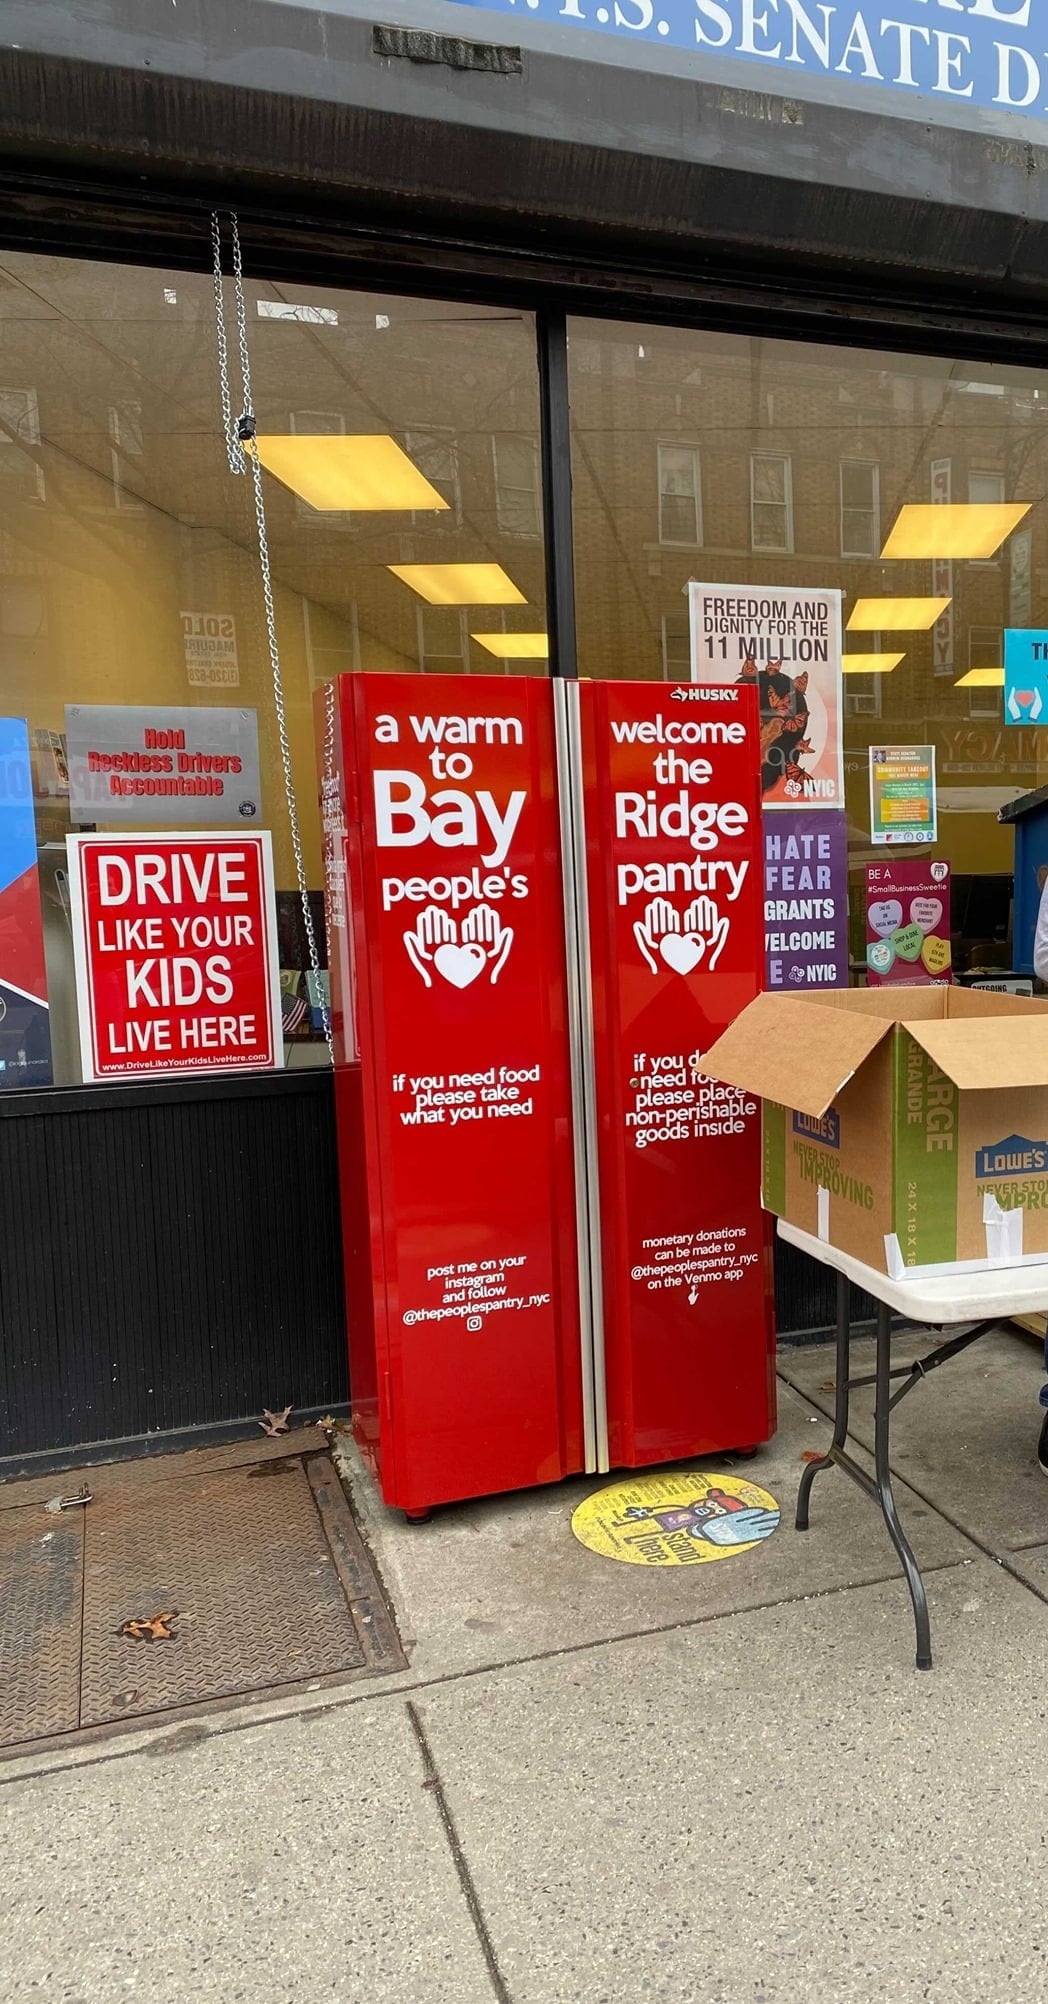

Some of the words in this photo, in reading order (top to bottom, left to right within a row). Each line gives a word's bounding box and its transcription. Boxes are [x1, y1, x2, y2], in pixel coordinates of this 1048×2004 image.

[694, 0, 974, 97] SENATE
[991, 41, 1048, 112] D
[703, 597, 787, 619] FREEDOM
[792, 601, 828, 620] AND
[704, 617, 763, 635] DIGNITY
[768, 620, 796, 636] FOR
[800, 621, 828, 637] THE
[704, 635, 727, 660] 11
[738, 636, 828, 662] MILLION
[688, 688, 738, 701] HUSKY
[144, 728, 186, 750] Hold
[374, 714, 399, 743] a
[409, 715, 523, 745] warm
[610, 713, 747, 744] welcome
[87, 751, 174, 773] Reckless
[177, 752, 243, 774] Drivers
[428, 745, 473, 780] to
[653, 748, 713, 784] the
[110, 774, 225, 796] Accountable
[803, 778, 836, 798] NYIC
[373, 769, 527, 868] Bay
[614, 789, 749, 851] Ridge
[765, 834, 832, 860] HATE
[97, 852, 249, 907] DRIVE
[617, 854, 750, 905] pantry
[766, 865, 832, 892] FEAR
[868, 869, 881, 880] BE
[883, 868, 892, 879] A
[382, 866, 529, 911] people's
[97, 918, 165, 952] LIKE
[170, 915, 254, 948] YOUR
[126, 954, 234, 1009] KIDS
[807, 963, 837, 983] NYIC
[108, 1019, 172, 1054] LIVE
[180, 1014, 257, 1049] HERE
[102, 1053, 267, 1072] www.DriveLikeYourKidsLiveHere.com
[633, 1053, 646, 1072] if
[650, 1055, 683, 1075] you
[392, 1074, 406, 1092] if
[409, 1076, 444, 1095] you
[449, 1068, 495, 1088] need
[499, 1064, 540, 1084] food
[640, 1068, 686, 1089] need
[416, 1089, 476, 1113] please
[480, 1084, 520, 1102] take
[636, 1089, 694, 1112] please
[699, 1084, 747, 1106] place
[926, 1057, 954, 1153] ARGE
[400, 1106, 445, 1126] what
[449, 1106, 483, 1126] you
[487, 1098, 533, 1118] need
[625, 1098, 757, 1128] non-perishable
[635, 1122, 689, 1148] goods
[694, 1117, 746, 1138] inside
[793, 1141, 818, 1161] NEVER
[819, 1151, 840, 1170] STOP
[983, 1149, 1045, 1173] LOWE'S
[799, 1154, 875, 1211] IMPROVING
[907, 1182, 917, 1198] 24
[976, 1182, 1019, 1197] NEVER
[1022, 1180, 1048, 1193] STO
[907, 1202, 917, 1212] X
[642, 1233, 694, 1249] monetary
[696, 1227, 747, 1242] donations
[907, 1218, 917, 1233] 18
[654, 1250, 673, 1261] can
[676, 1247, 690, 1258] be
[692, 1243, 722, 1256] made
[724, 1242, 736, 1252] to
[907, 1236, 917, 1246] X
[427, 1264, 455, 1281] post
[457, 1262, 478, 1274] me
[480, 1260, 496, 1271] on
[499, 1255, 527, 1271] your
[631, 1252, 759, 1281] @thepeoplespantry_nyc
[907, 1251, 917, 1266] 18
[444, 1272, 504, 1290] instagram
[647, 1279, 662, 1290] on
[664, 1275, 683, 1288] the
[684, 1272, 722, 1285] Venmo
[724, 1269, 744, 1281] app
[442, 1289, 465, 1304] and
[467, 1285, 507, 1300] follow
[402, 1292, 551, 1326] @thepeoplespantry_nyc
[634, 1533, 669, 1563] here
[661, 1532, 706, 1563] stand
